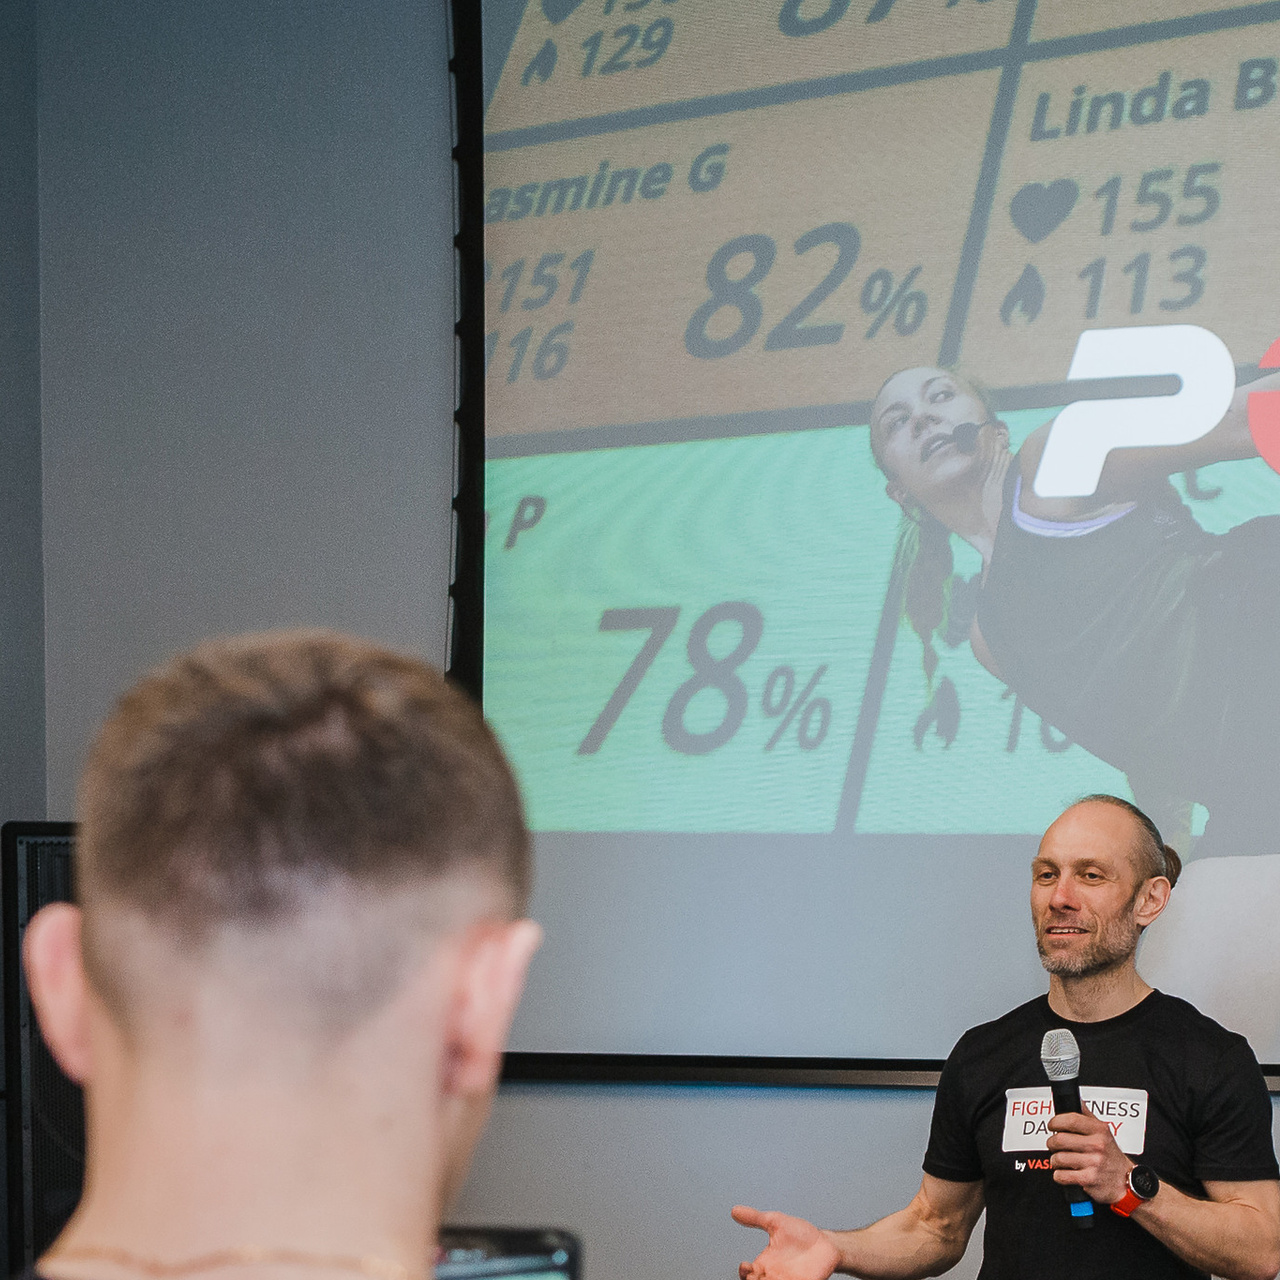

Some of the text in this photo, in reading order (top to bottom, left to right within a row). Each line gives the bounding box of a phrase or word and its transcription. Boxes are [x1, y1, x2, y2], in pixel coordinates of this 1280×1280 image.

[580, 17, 675, 78] 129
[1029, 57, 1280, 142] Linda B
[687, 143, 731, 194] G
[1092, 161, 1223, 238] 155
[500, 249, 597, 315] 151
[684, 221, 928, 360] 82%
[1077, 246, 1210, 319] 113
[504, 495, 547, 551] P
[578, 600, 833, 757] 78%
[1023, 1121, 1057, 1135] DA
[1015, 1160, 1026, 1172] by
